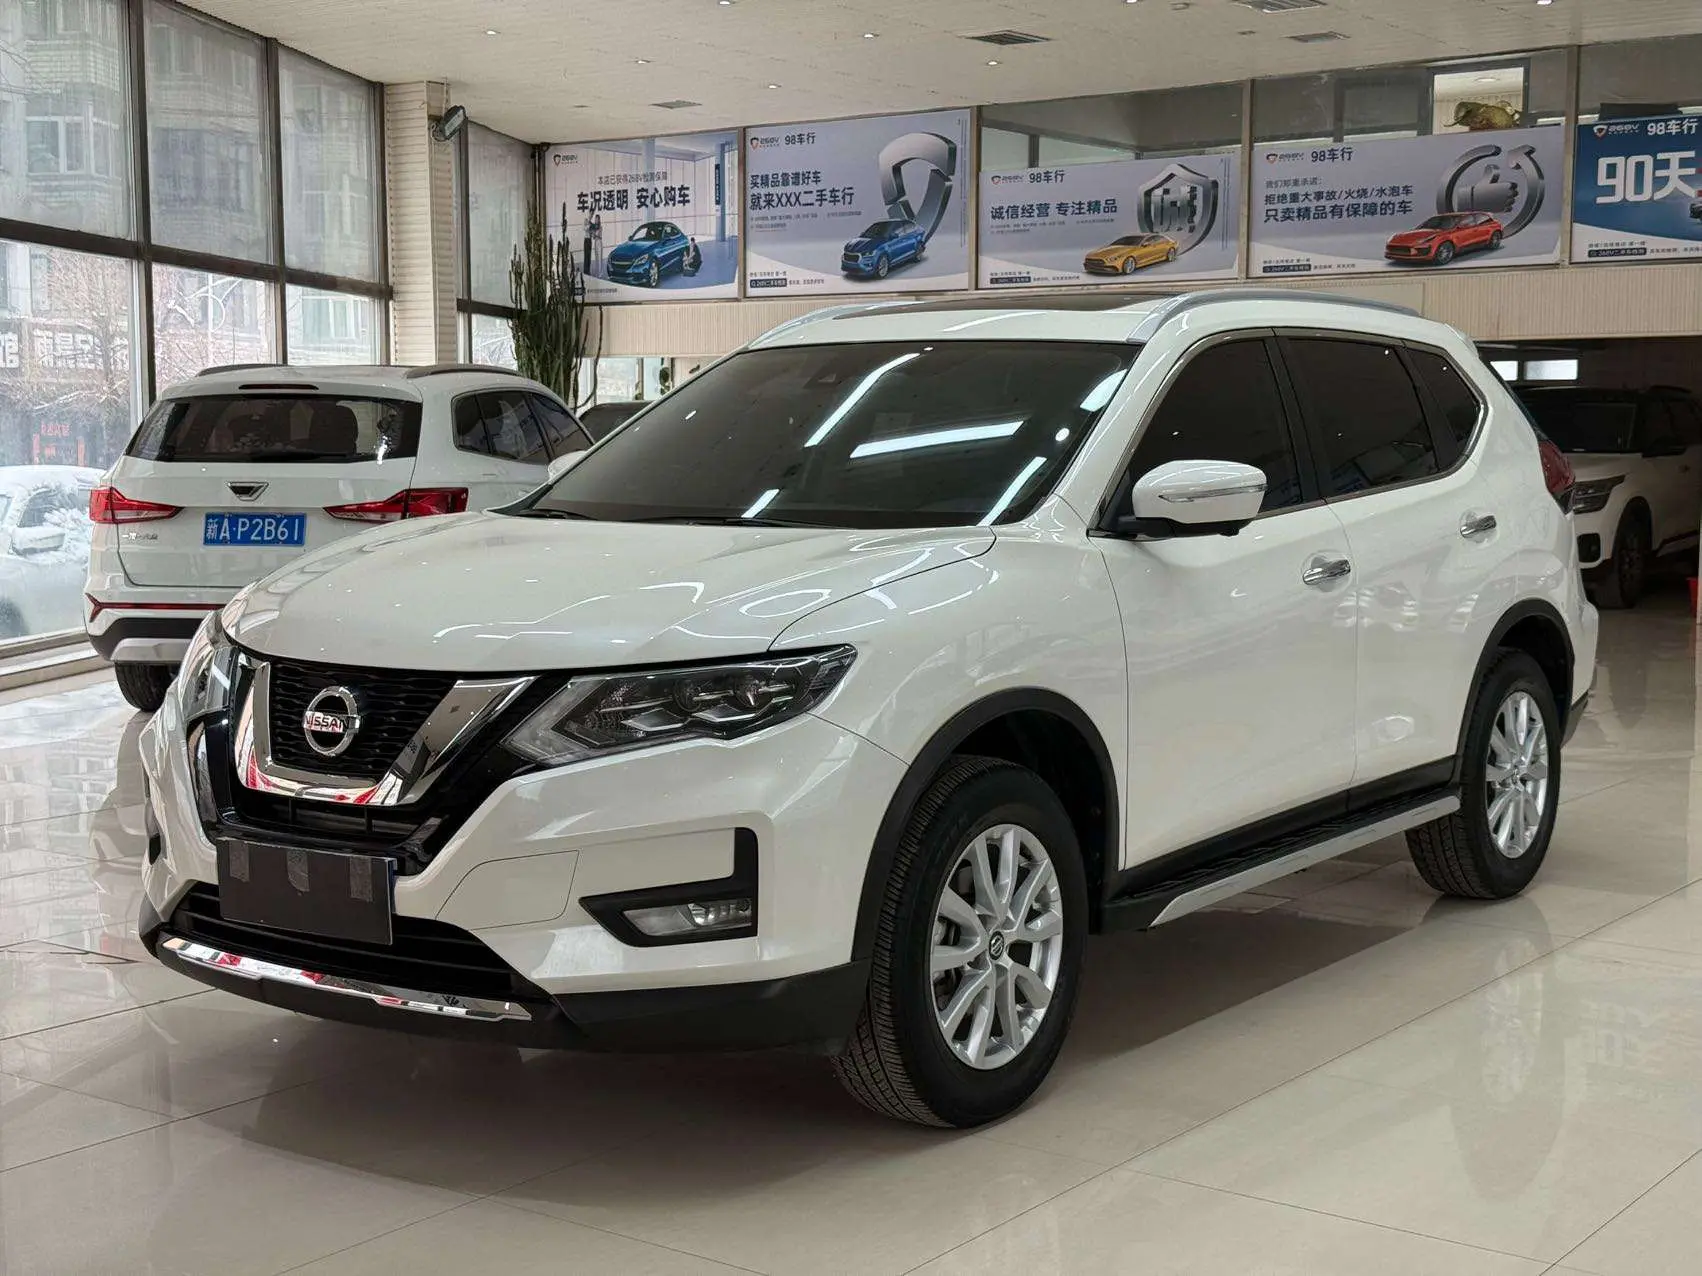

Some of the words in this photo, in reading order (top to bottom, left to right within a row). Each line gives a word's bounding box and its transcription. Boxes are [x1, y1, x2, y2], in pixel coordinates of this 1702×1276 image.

[1647, 118, 1699, 136] 98车行
[784, 132, 816, 145] 98车行
[1311, 147, 1354, 162] 98车行
[750, 170, 821, 190] 买精品靠谱好车
[1029, 169, 1065, 184] 98车行
[577, 189, 629, 213] 车况透明
[636, 184, 691, 210] 安心购车
[749, 187, 855, 211] 就来XXX二手车行
[1264, 184, 1414, 206] 拒绝重大事故/火烧/水泡车
[990, 202, 1050, 220] 诚信经营
[1055, 198, 1118, 217] 专注精品
[1264, 200, 1413, 223] 只卖精品有保障的车
[305, 711, 350, 730] NISSAN
